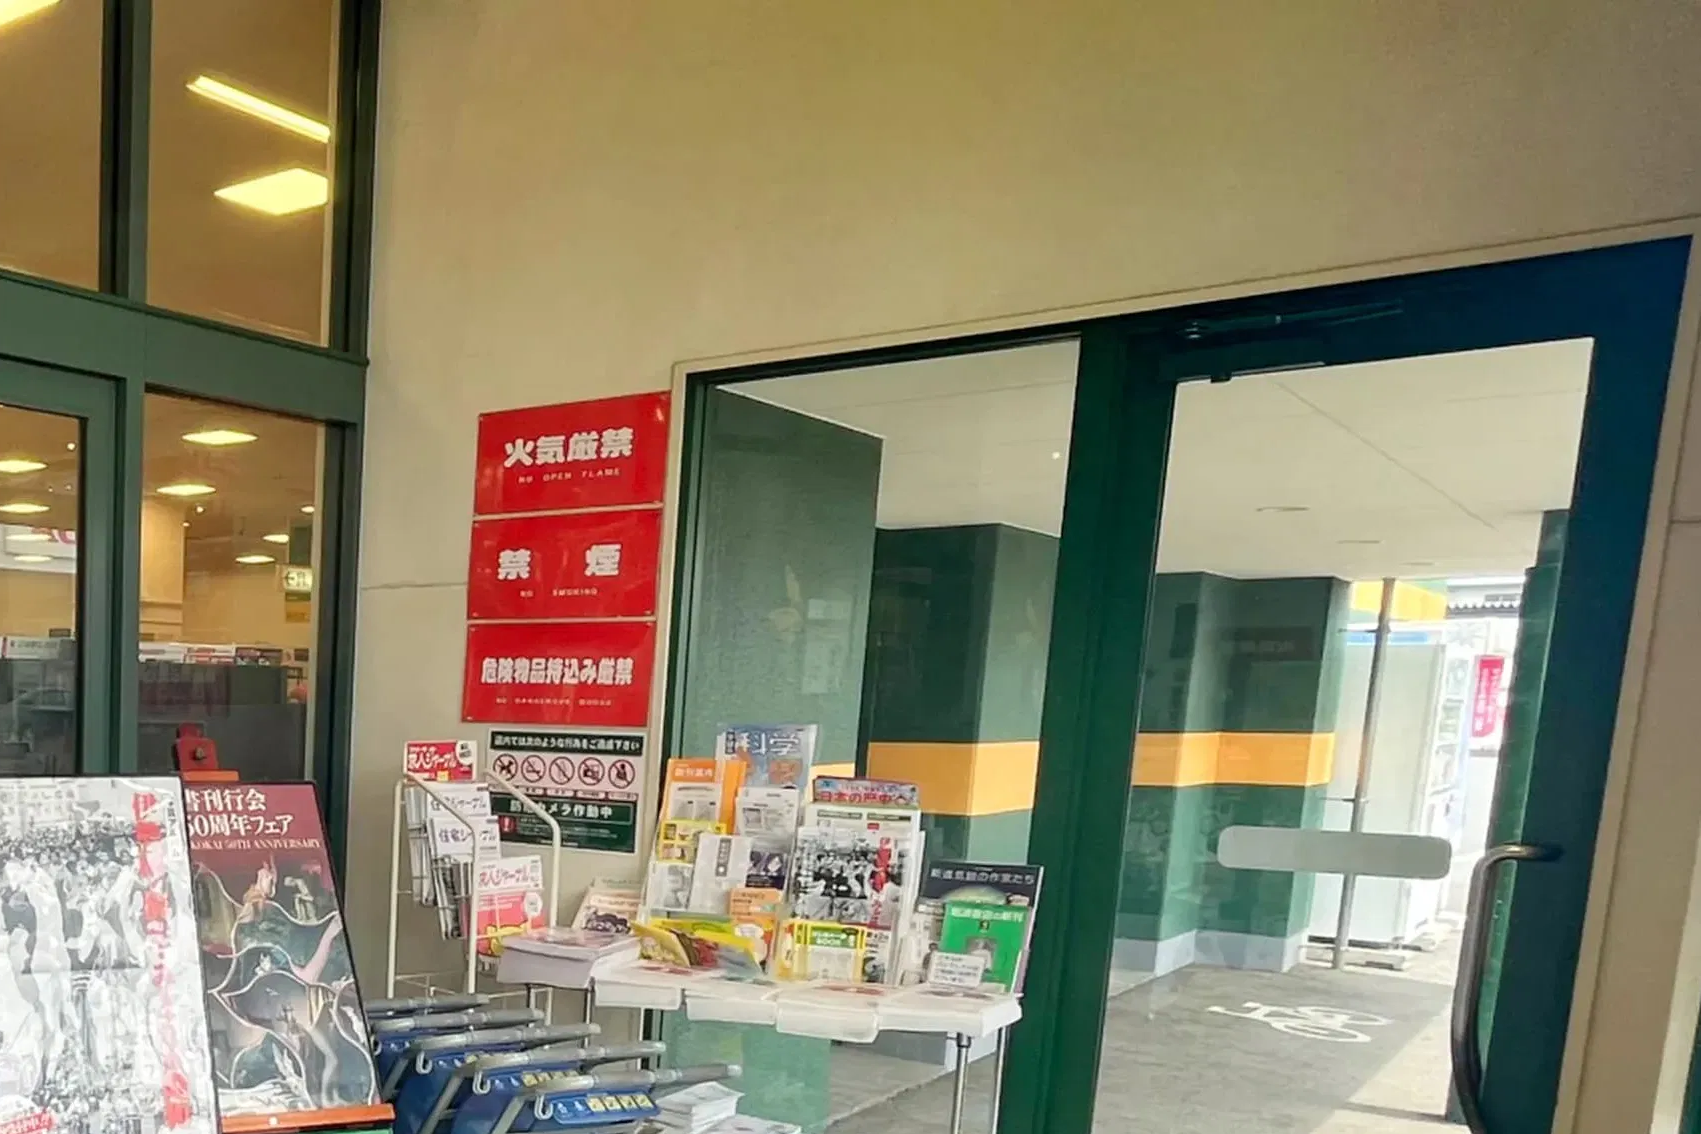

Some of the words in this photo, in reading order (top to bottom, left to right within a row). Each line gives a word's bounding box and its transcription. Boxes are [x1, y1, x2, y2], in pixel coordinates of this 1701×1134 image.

[504, 427, 634, 468] 火気厳禁
[543, 472, 572, 482] OPEN
[582, 468, 620, 478] FLAME
[497, 547, 533, 580] 禁
[585, 543, 622, 578] 煙
